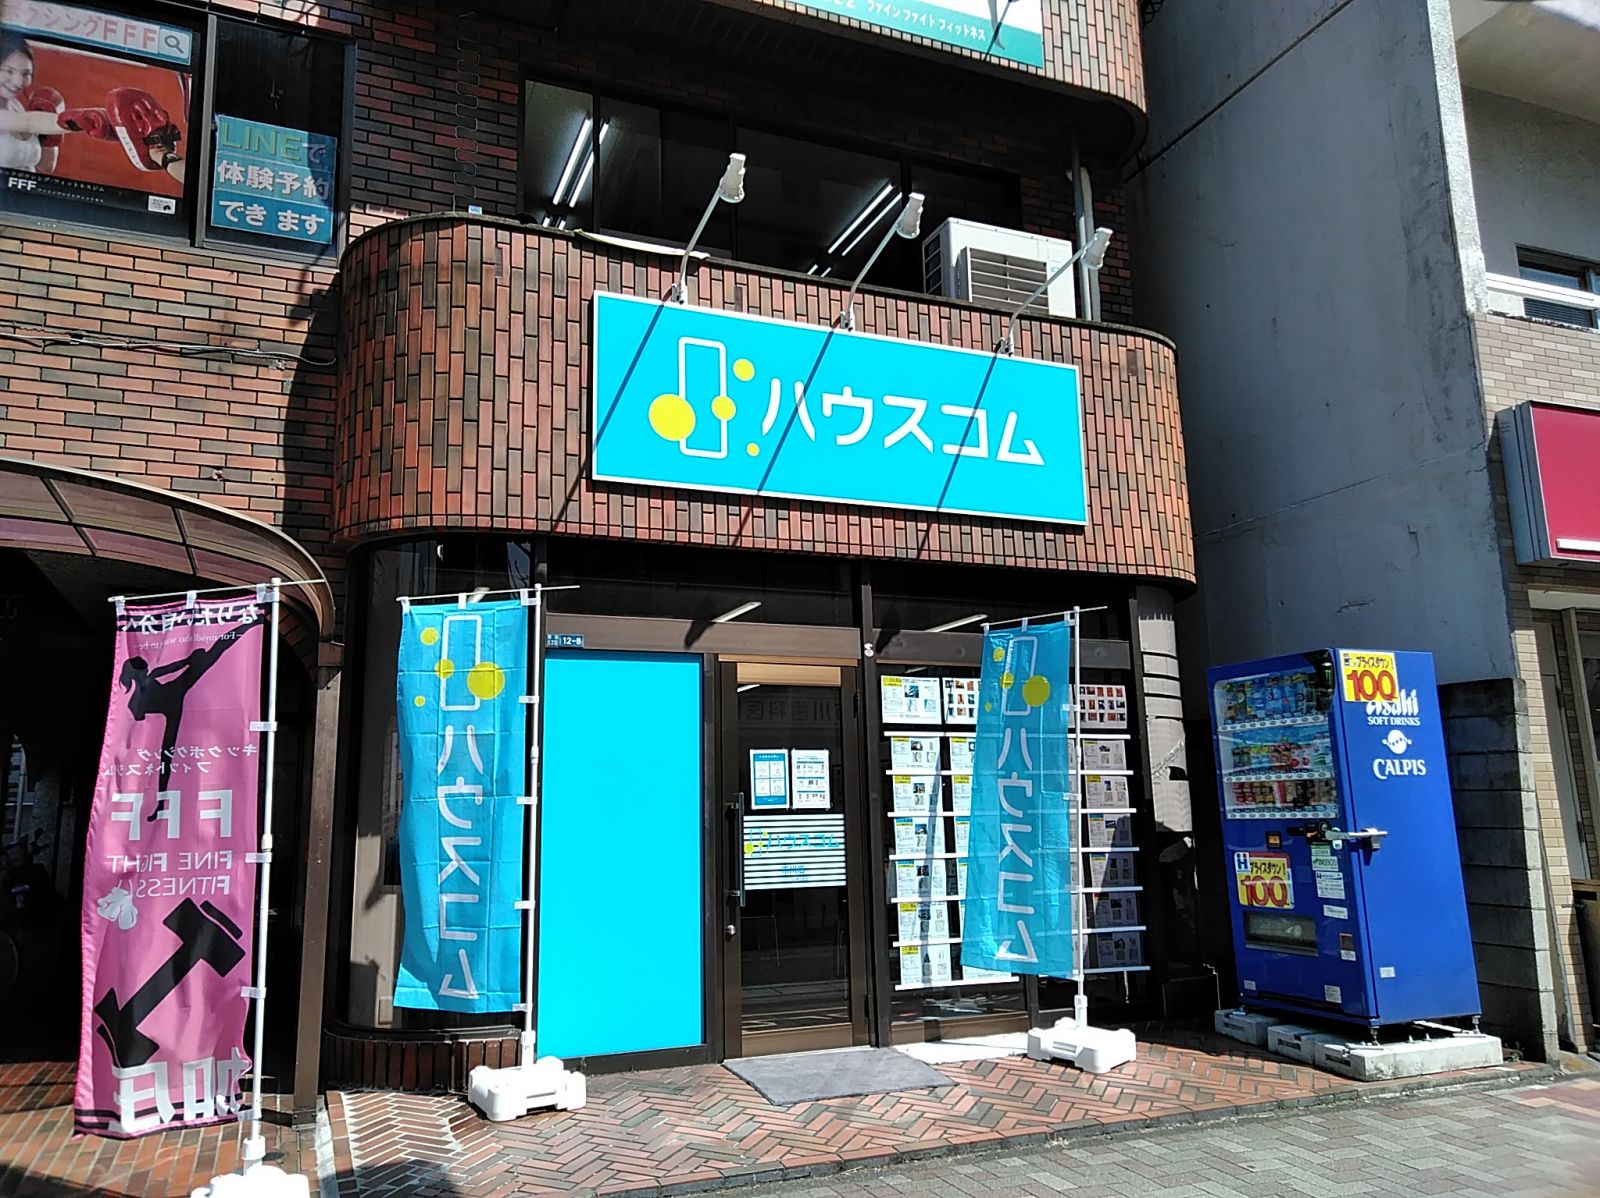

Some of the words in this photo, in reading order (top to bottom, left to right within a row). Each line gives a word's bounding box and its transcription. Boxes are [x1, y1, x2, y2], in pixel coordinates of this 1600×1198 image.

[903, 9, 936, 28] ファイト
[939, 19, 987, 41] フィットネス
[222, 122, 326, 163] LINEで
[7, 176, 38, 191] FFF
[217, 160, 330, 200] 体験予約
[761, 377, 1046, 467] ハウスコム
[1346, 669, 1397, 701] 100
[1367, 716, 1388, 726] SOFT
[1390, 717, 1421, 727] DRINKS
[1373, 758, 1427, 780] CALPIS
[1240, 875, 1288, 908] 100
